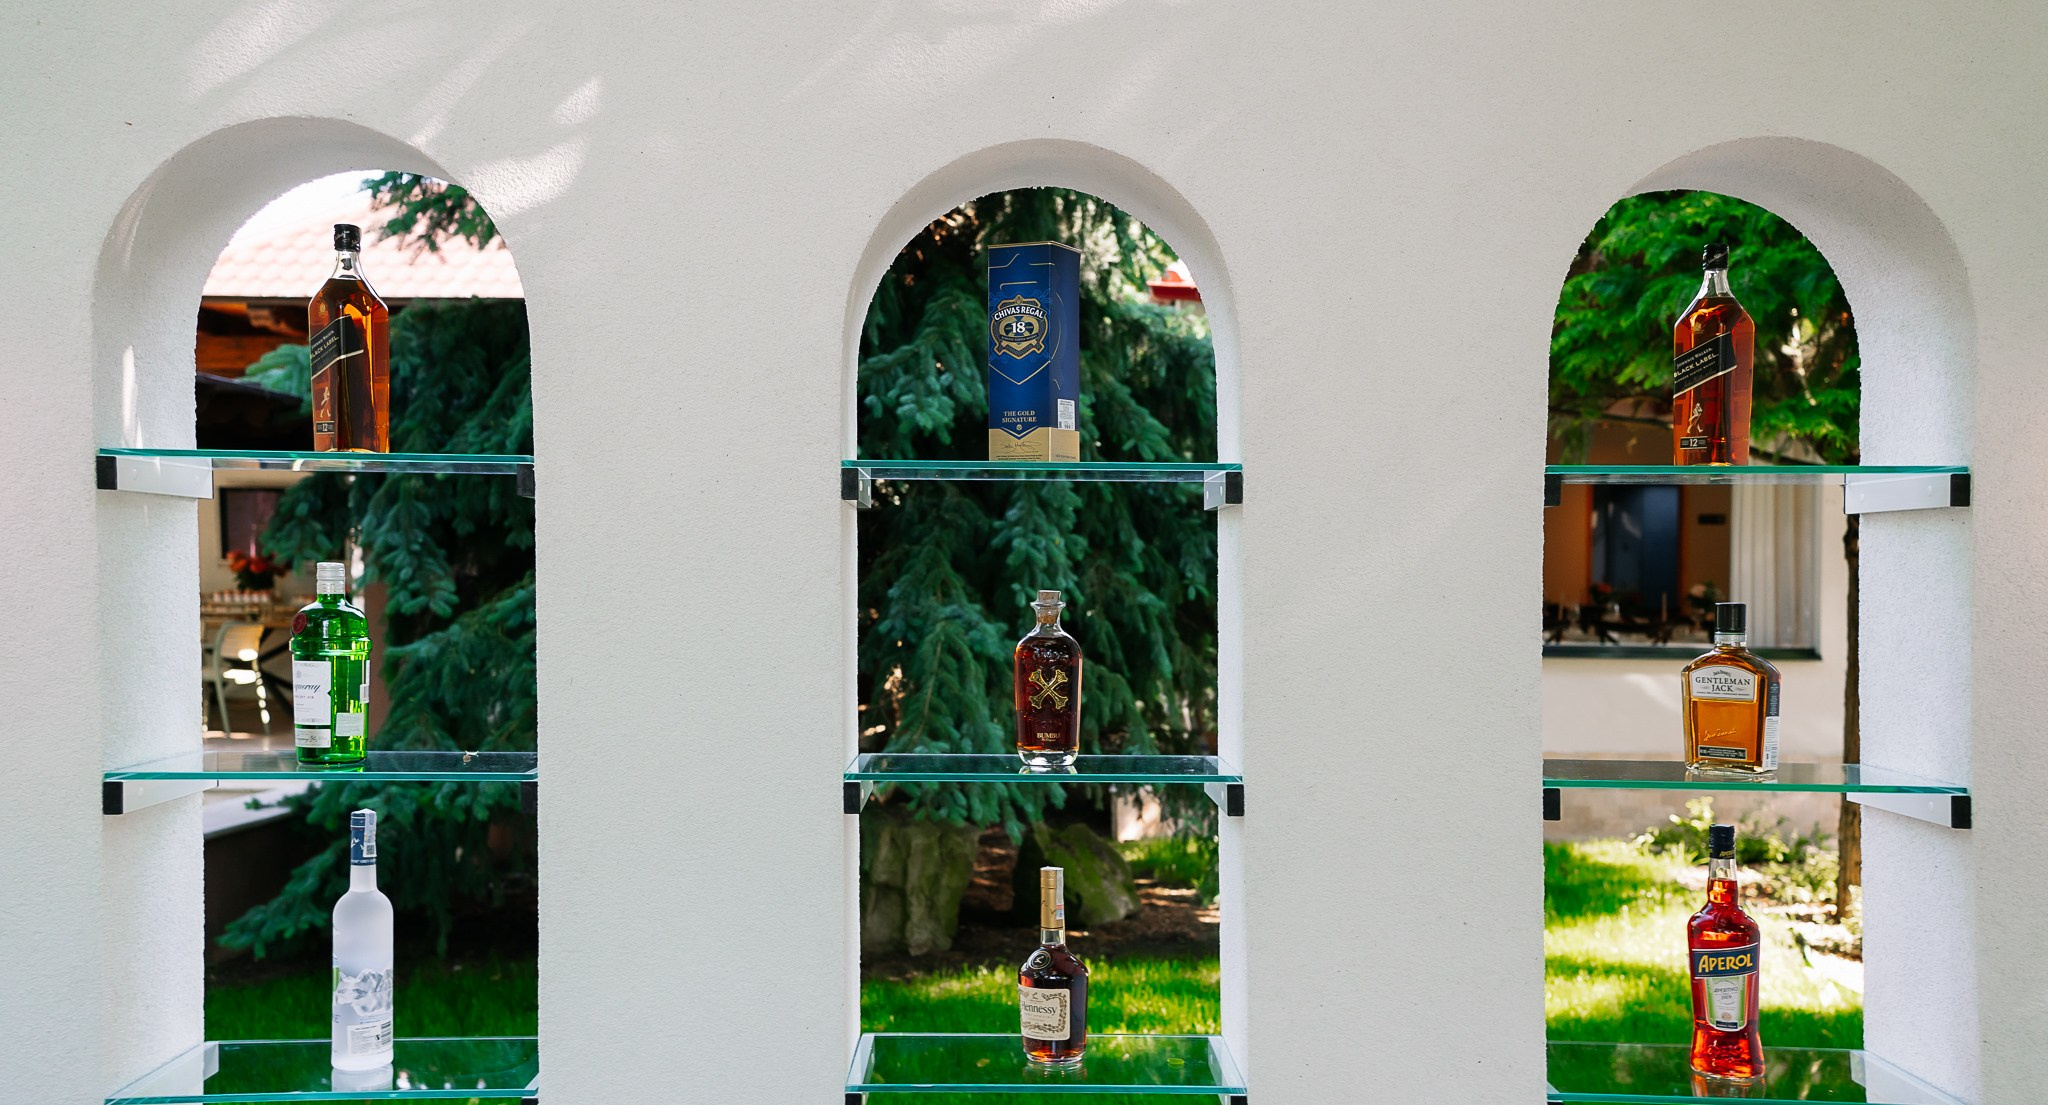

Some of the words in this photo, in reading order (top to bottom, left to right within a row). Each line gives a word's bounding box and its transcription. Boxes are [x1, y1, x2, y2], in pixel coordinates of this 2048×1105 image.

[994, 306, 1020, 321] CHIVAS
[1021, 306, 1044, 319] REGAL
[1011, 321, 1026, 333] 18
[323, 335, 338, 349] LABEL
[1673, 363, 1695, 378] BLACK
[1695, 353, 1717, 367] LABEL
[1690, 438, 1698, 447] 12
[1695, 676, 1751, 686] GENTLEMAN
[1698, 953, 1753, 973] APEROL
